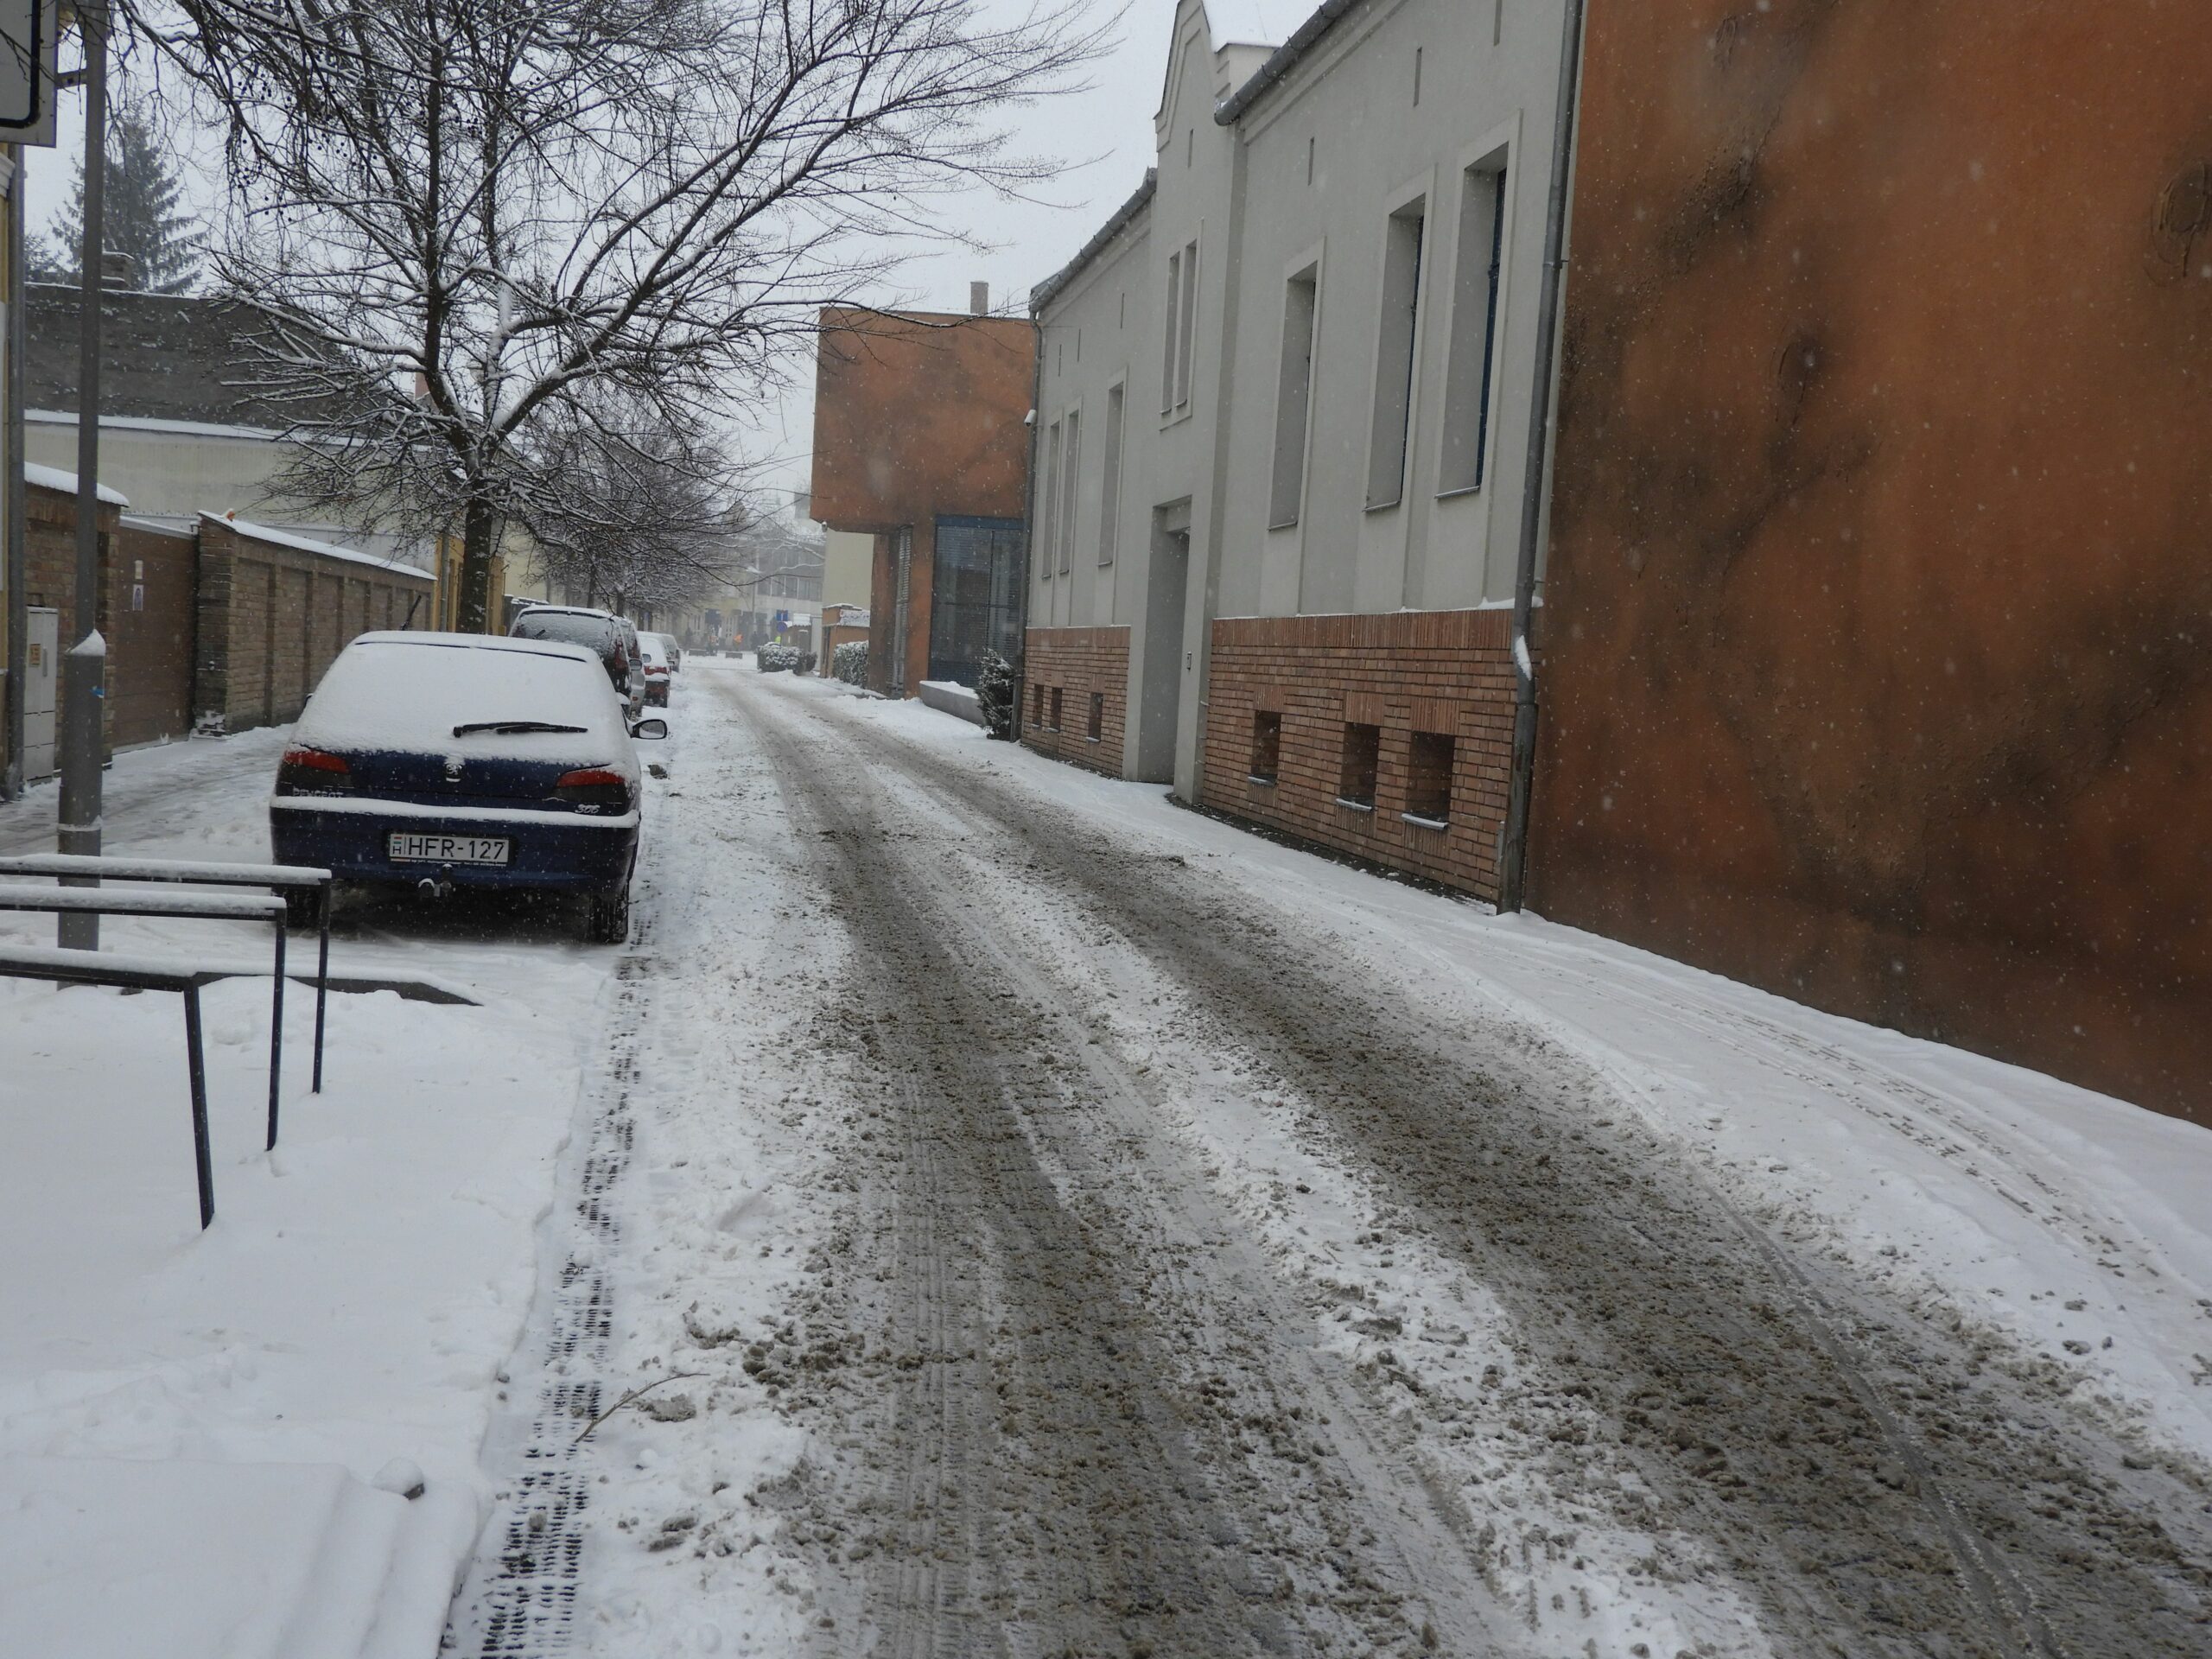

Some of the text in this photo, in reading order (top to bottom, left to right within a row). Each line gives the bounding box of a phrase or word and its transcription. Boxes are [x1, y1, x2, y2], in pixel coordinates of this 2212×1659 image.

[575, 804, 601, 813] 306
[392, 837, 505, 860] H HFR-127
